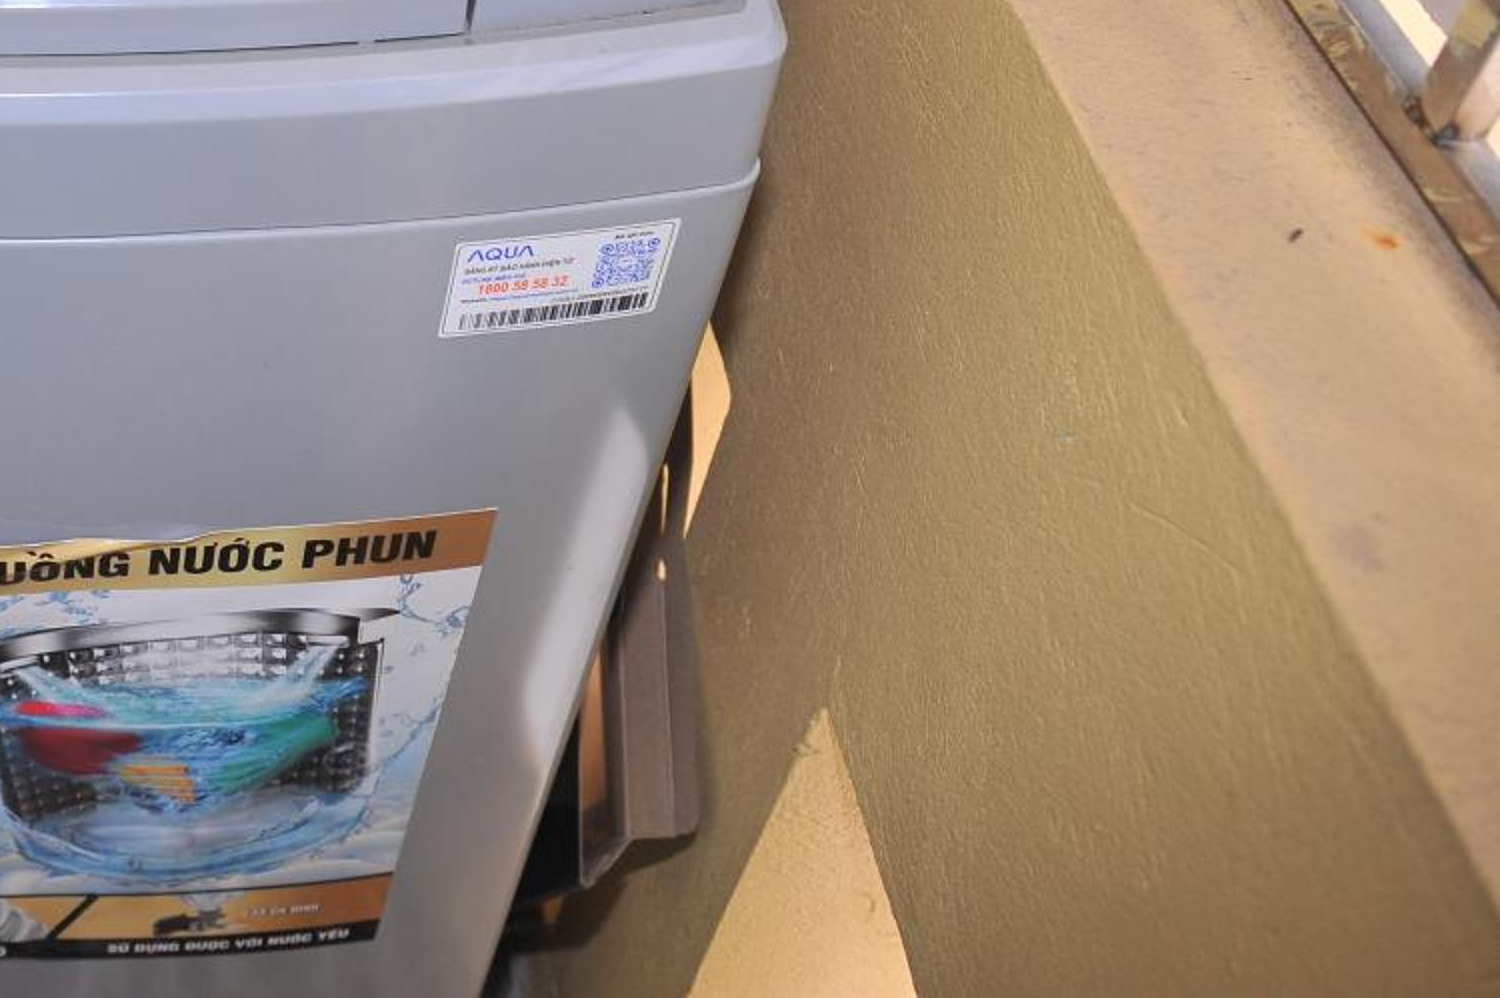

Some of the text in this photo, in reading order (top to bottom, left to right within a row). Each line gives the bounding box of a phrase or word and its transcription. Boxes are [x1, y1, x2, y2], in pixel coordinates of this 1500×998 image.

[468, 245, 534, 262] AQUA
[148, 537, 285, 576] NƯỚC
[301, 529, 437, 569] PHUN
